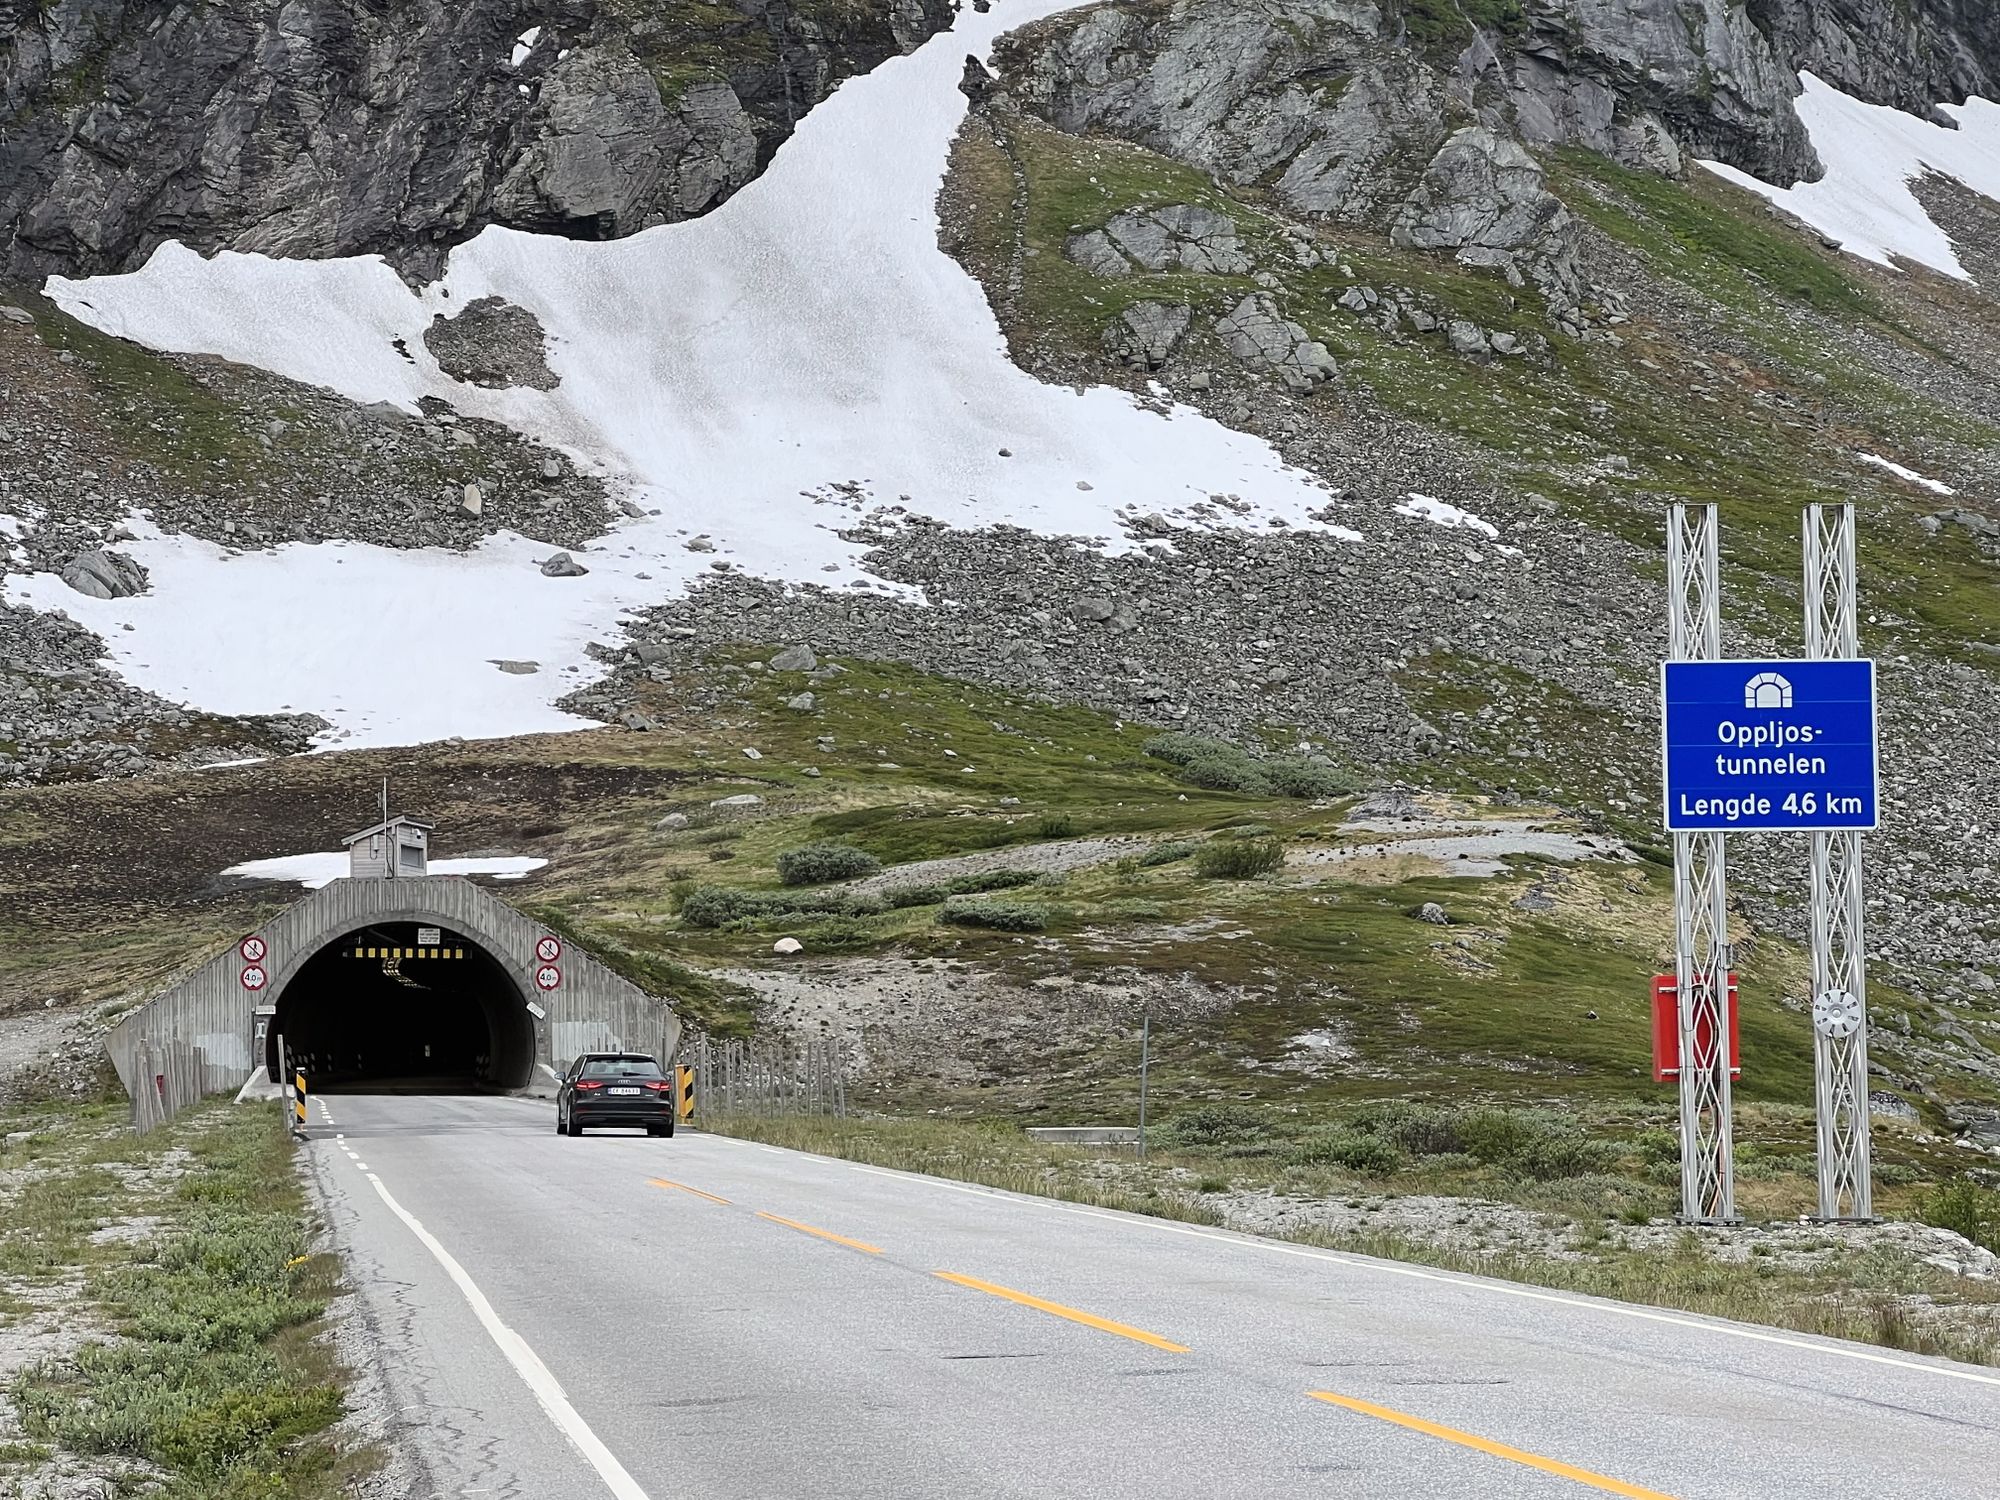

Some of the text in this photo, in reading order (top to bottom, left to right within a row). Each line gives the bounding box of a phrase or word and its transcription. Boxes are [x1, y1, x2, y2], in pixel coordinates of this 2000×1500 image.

[1718, 720, 1823, 748] Oppljos-
[1715, 752, 1826, 775] tunnelen
[1681, 792, 1862, 821] Lengde 4,6 km
